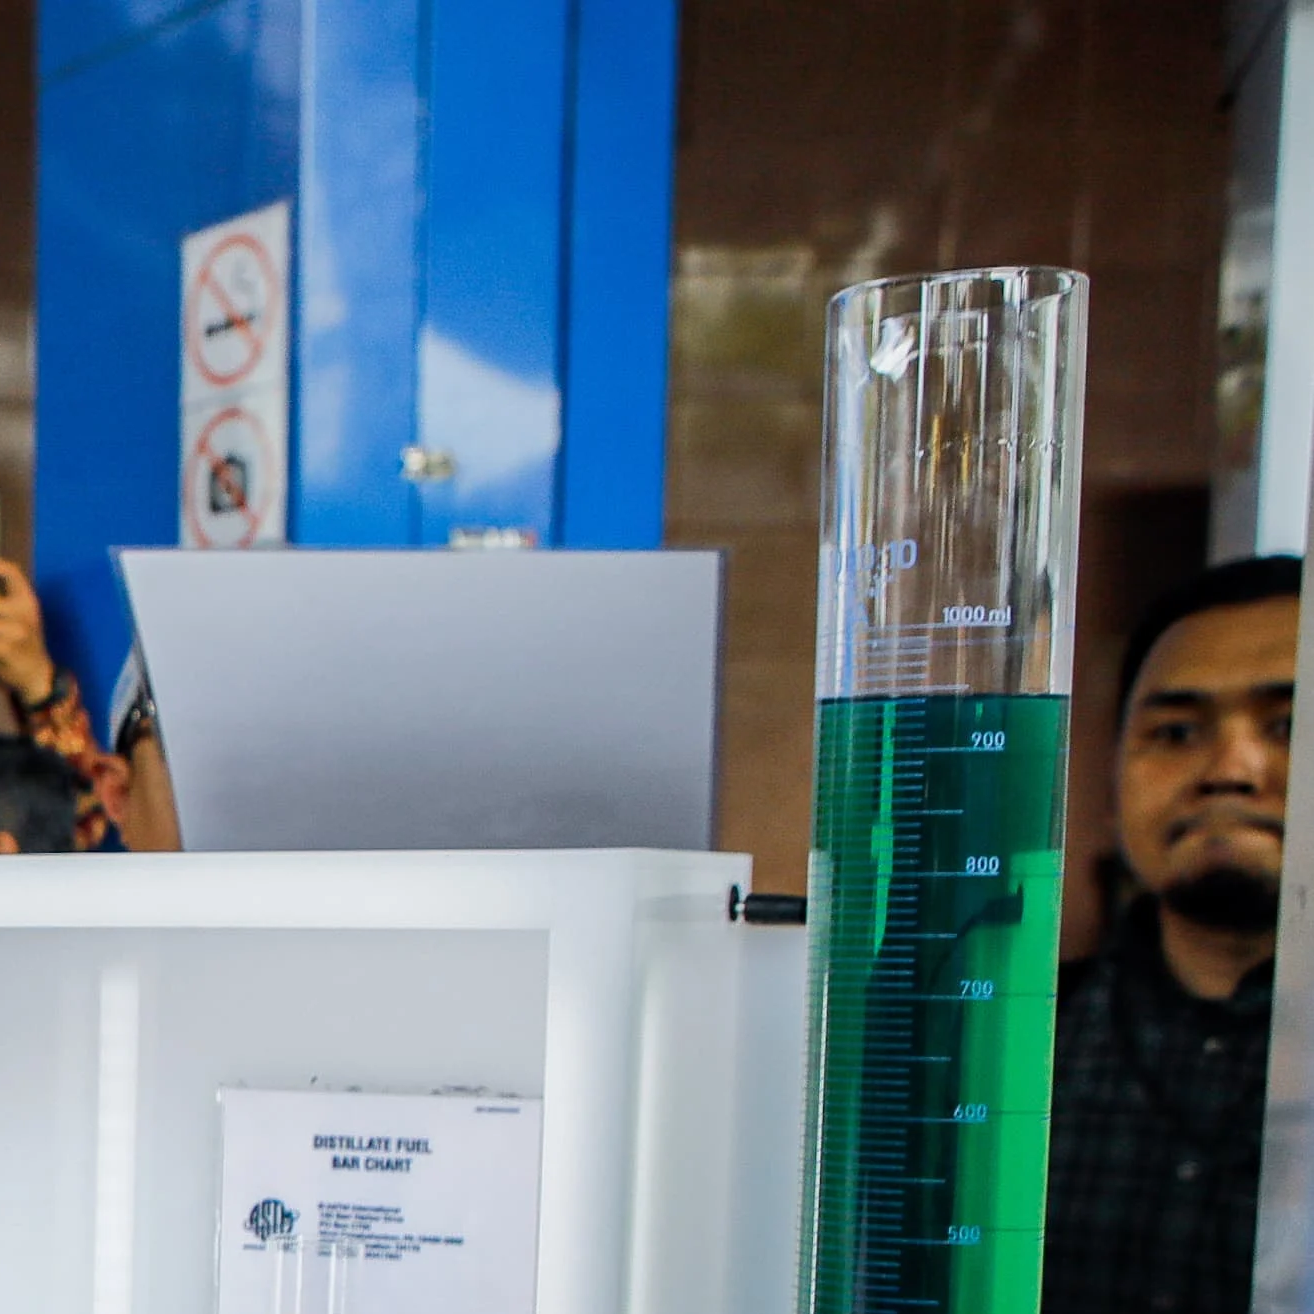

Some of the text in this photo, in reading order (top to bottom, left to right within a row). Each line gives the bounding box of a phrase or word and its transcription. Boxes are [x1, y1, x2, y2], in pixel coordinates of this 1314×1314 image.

[942, 605, 1012, 624] 1000 ml
[972, 731, 1006, 747] 900
[966, 856, 1000, 873] 800
[960, 980, 994, 997] 700
[953, 1103, 987, 1120] 600
[312, 1134, 433, 1154] DISTILLATE FUEL
[331, 1155, 414, 1172] BAR CHART
[947, 1226, 981, 1243] 500
